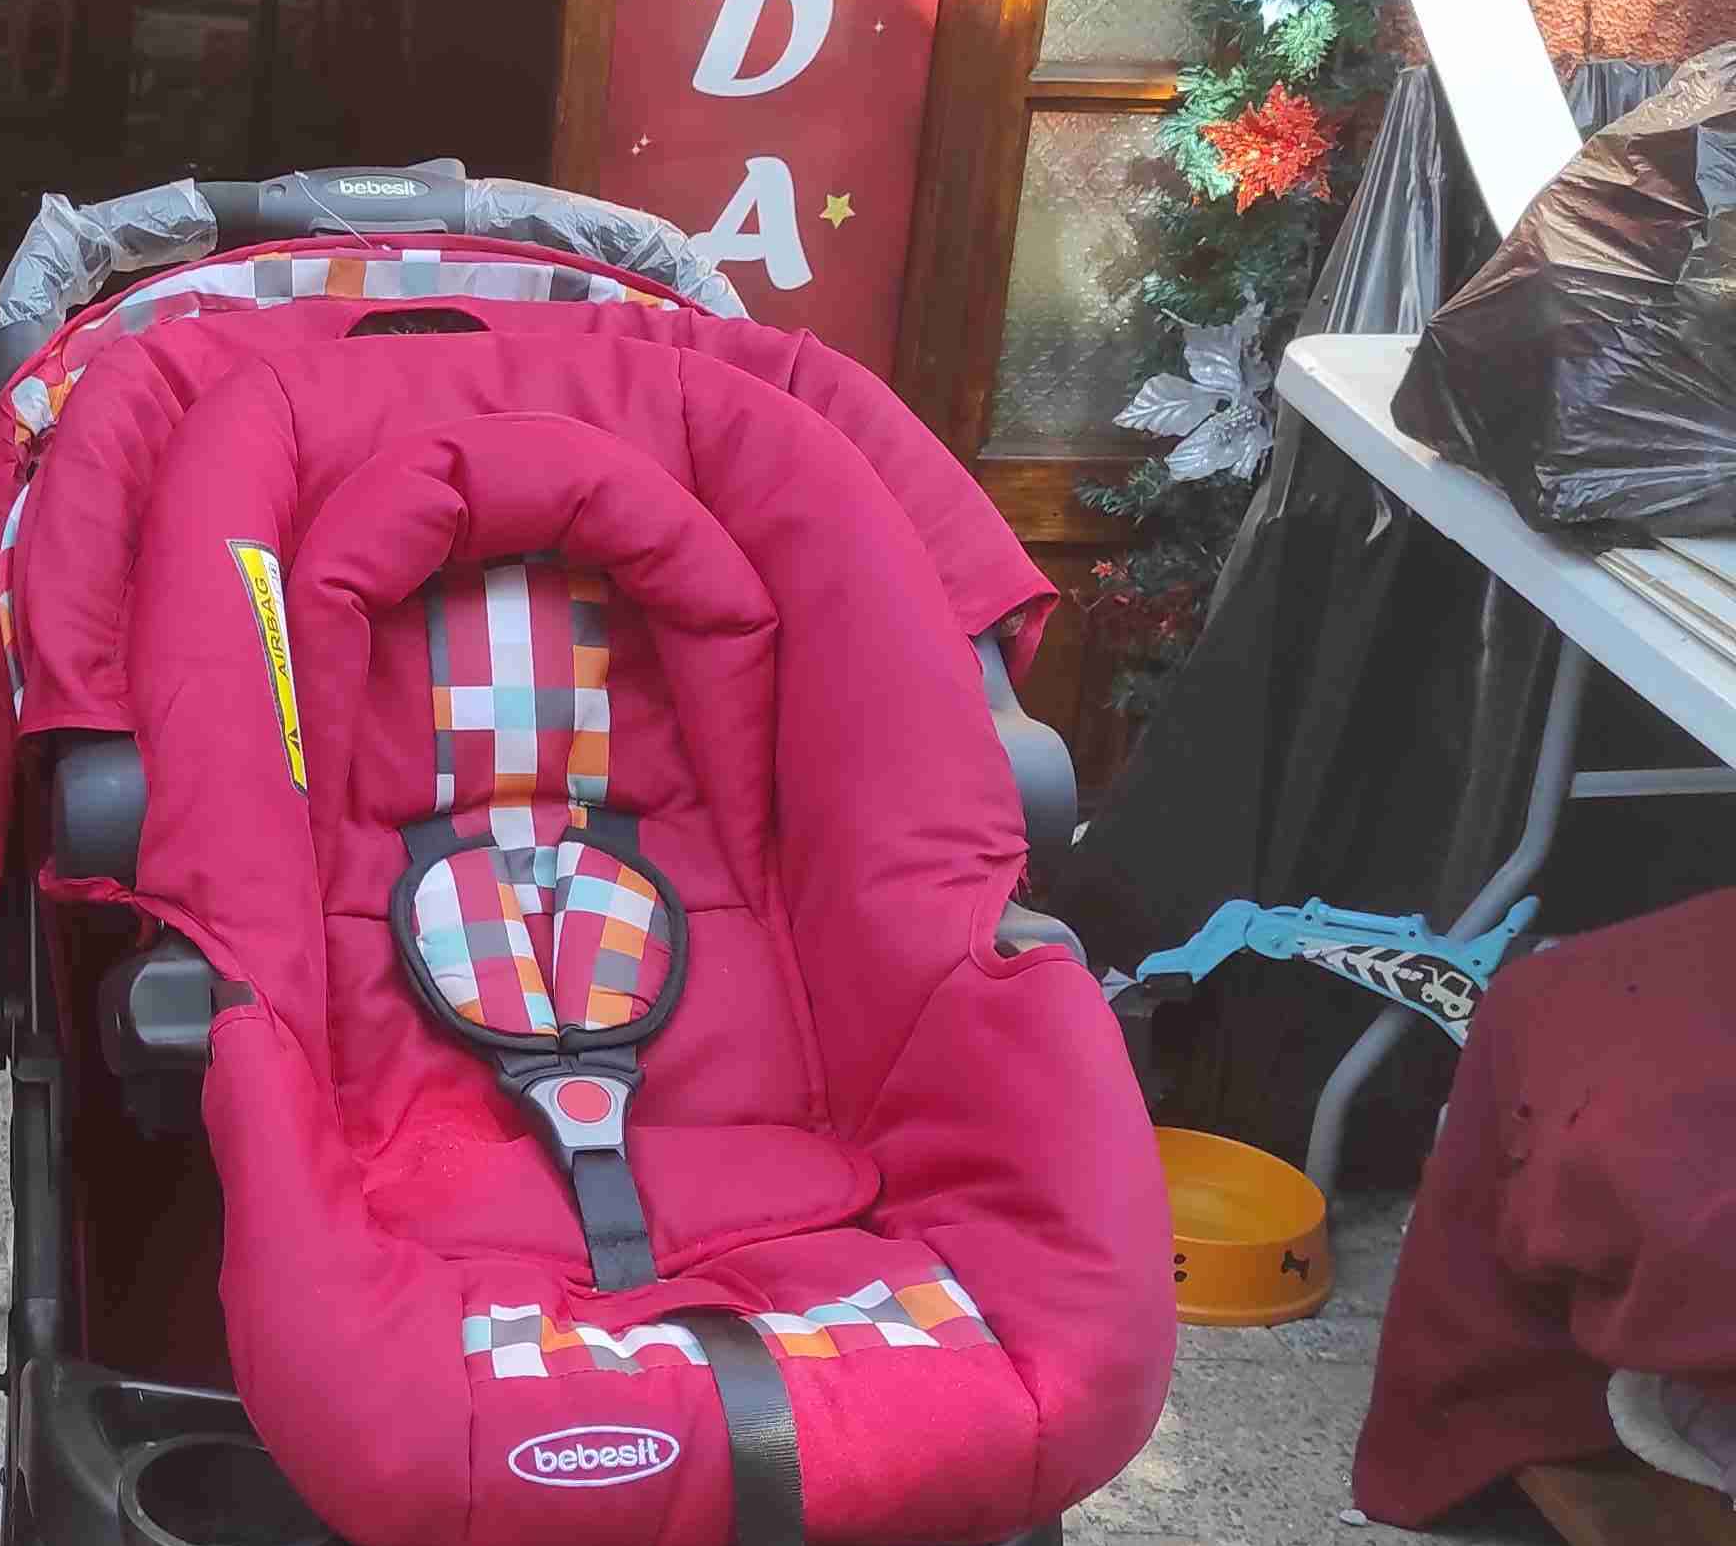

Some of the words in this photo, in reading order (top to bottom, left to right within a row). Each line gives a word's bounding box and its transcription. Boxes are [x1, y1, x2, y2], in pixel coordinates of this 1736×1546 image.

[339, 180, 417, 196] bebesit
[255, 576, 290, 680] AIRBAG
[533, 1437, 660, 1472] bebesit
